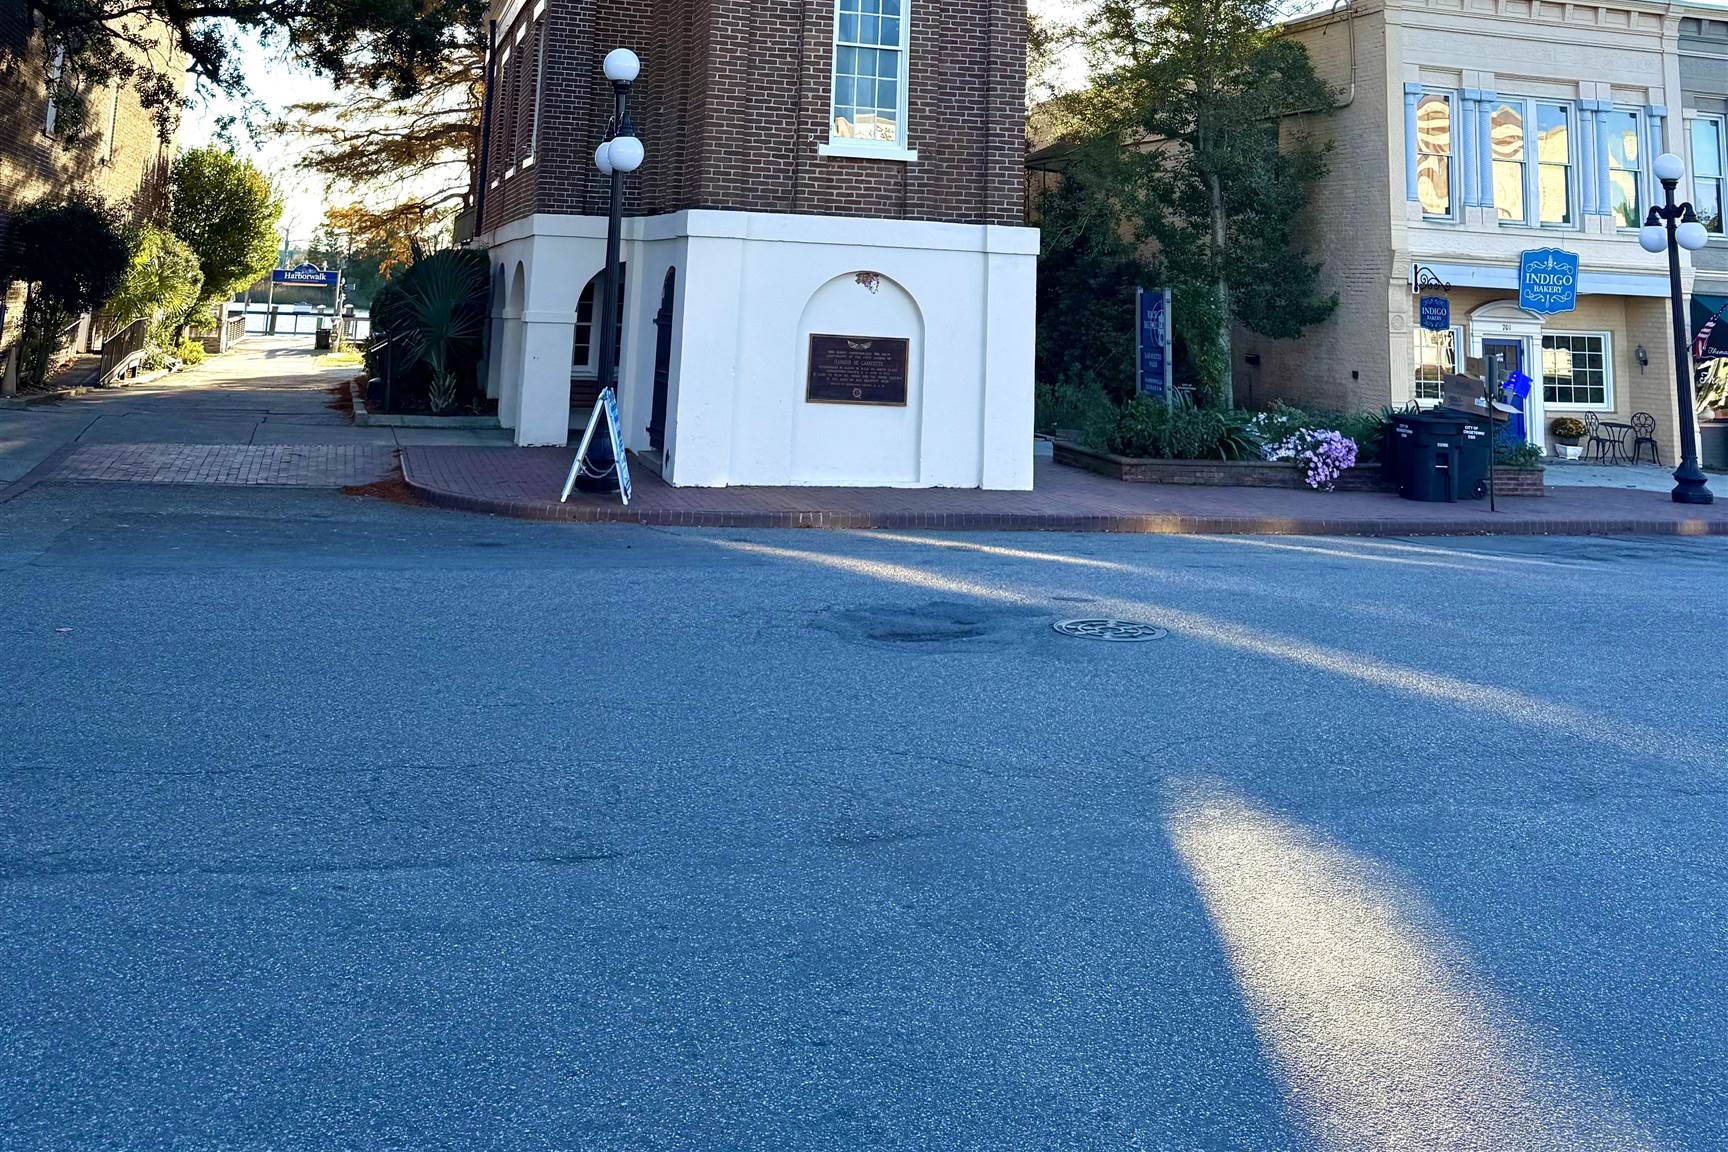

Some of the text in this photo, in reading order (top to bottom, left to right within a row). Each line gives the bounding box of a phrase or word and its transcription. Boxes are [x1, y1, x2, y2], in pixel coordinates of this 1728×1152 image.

[284, 272, 327, 280] Harborwalk
[1526, 272, 1573, 286] INDIGO
[1534, 285, 1564, 294] BAKERY
[1422, 306, 1447, 317] INDIGO
